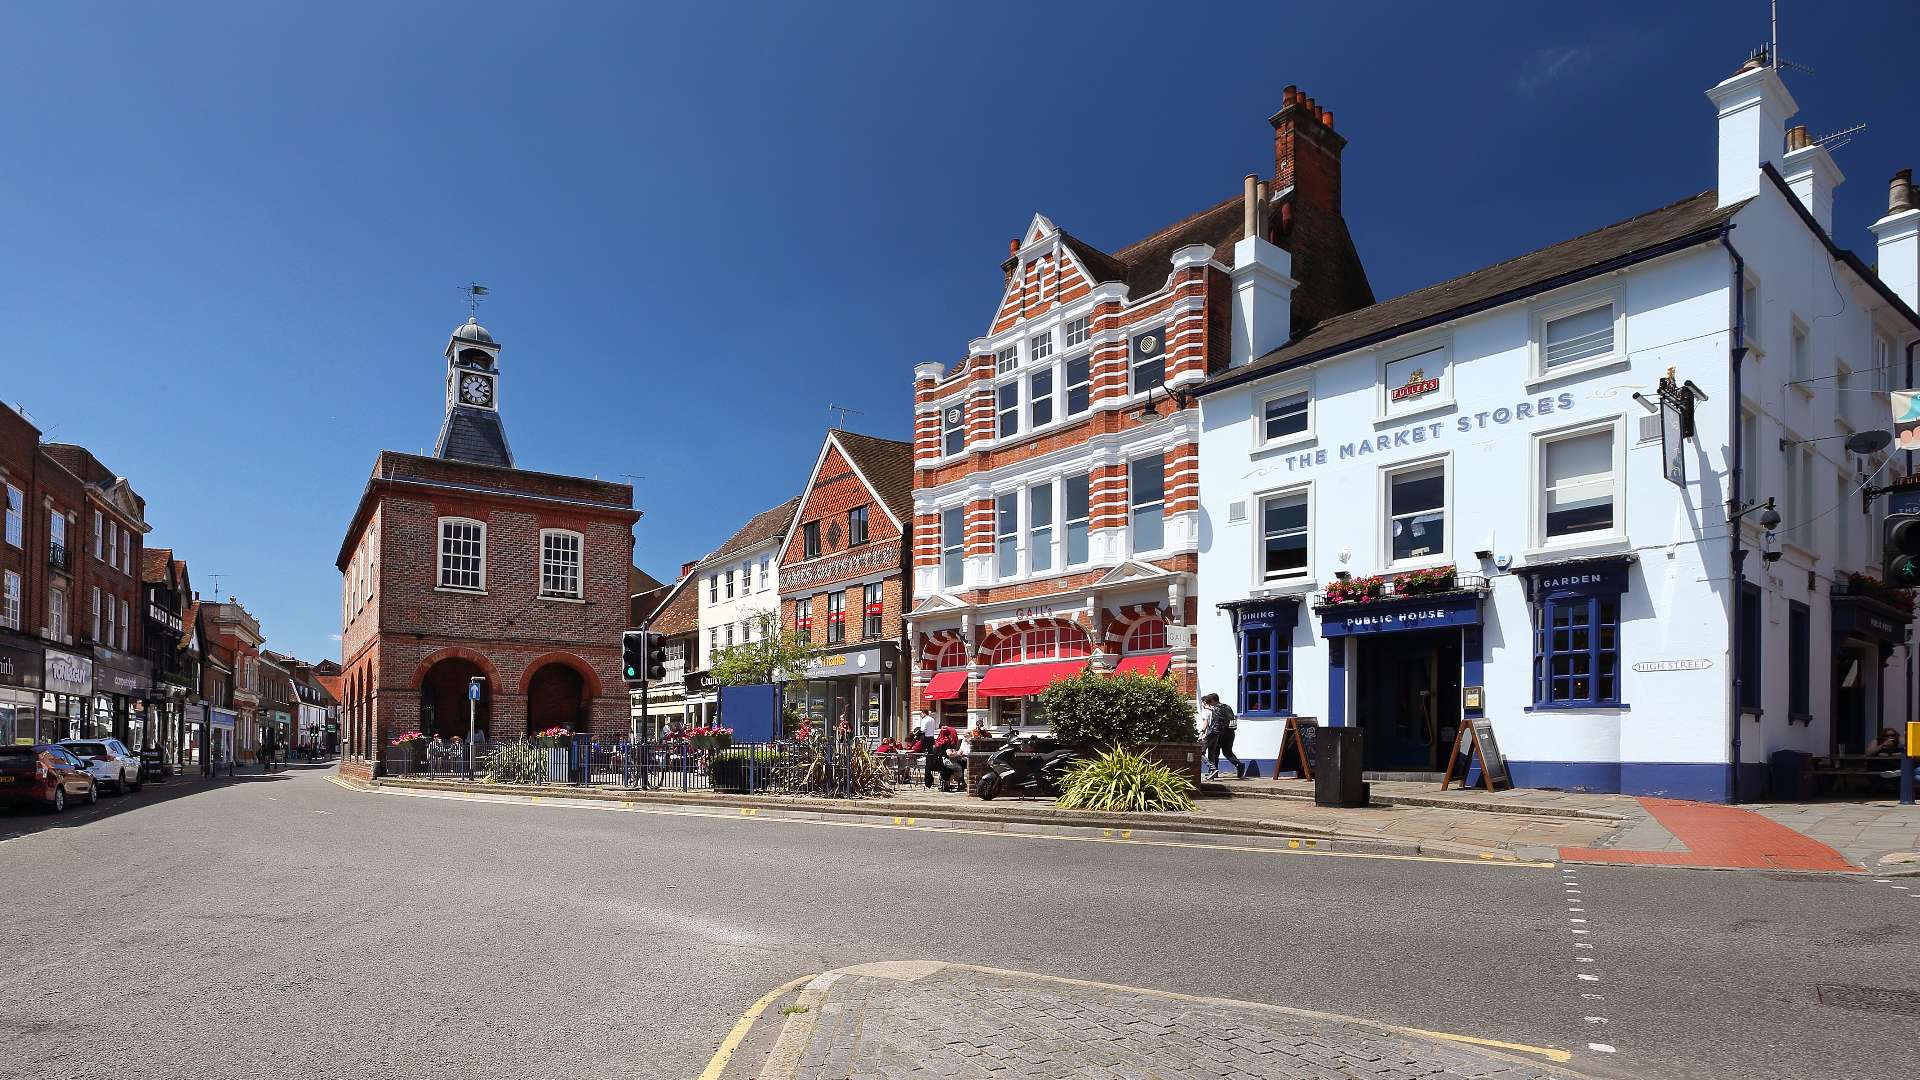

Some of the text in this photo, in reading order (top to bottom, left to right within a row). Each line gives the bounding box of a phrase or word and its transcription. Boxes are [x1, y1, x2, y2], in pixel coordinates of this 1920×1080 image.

[1285, 392, 1575, 471] THE MARKET STORES
[1543, 574, 1601, 588] GARDEN
[1242, 611, 1275, 620] DINING
[1346, 609, 1445, 626] PUBLIC HOUSE
[1638, 660, 1706, 671] HIGH STREET
[52, 663, 87, 684] TONI&GUY
